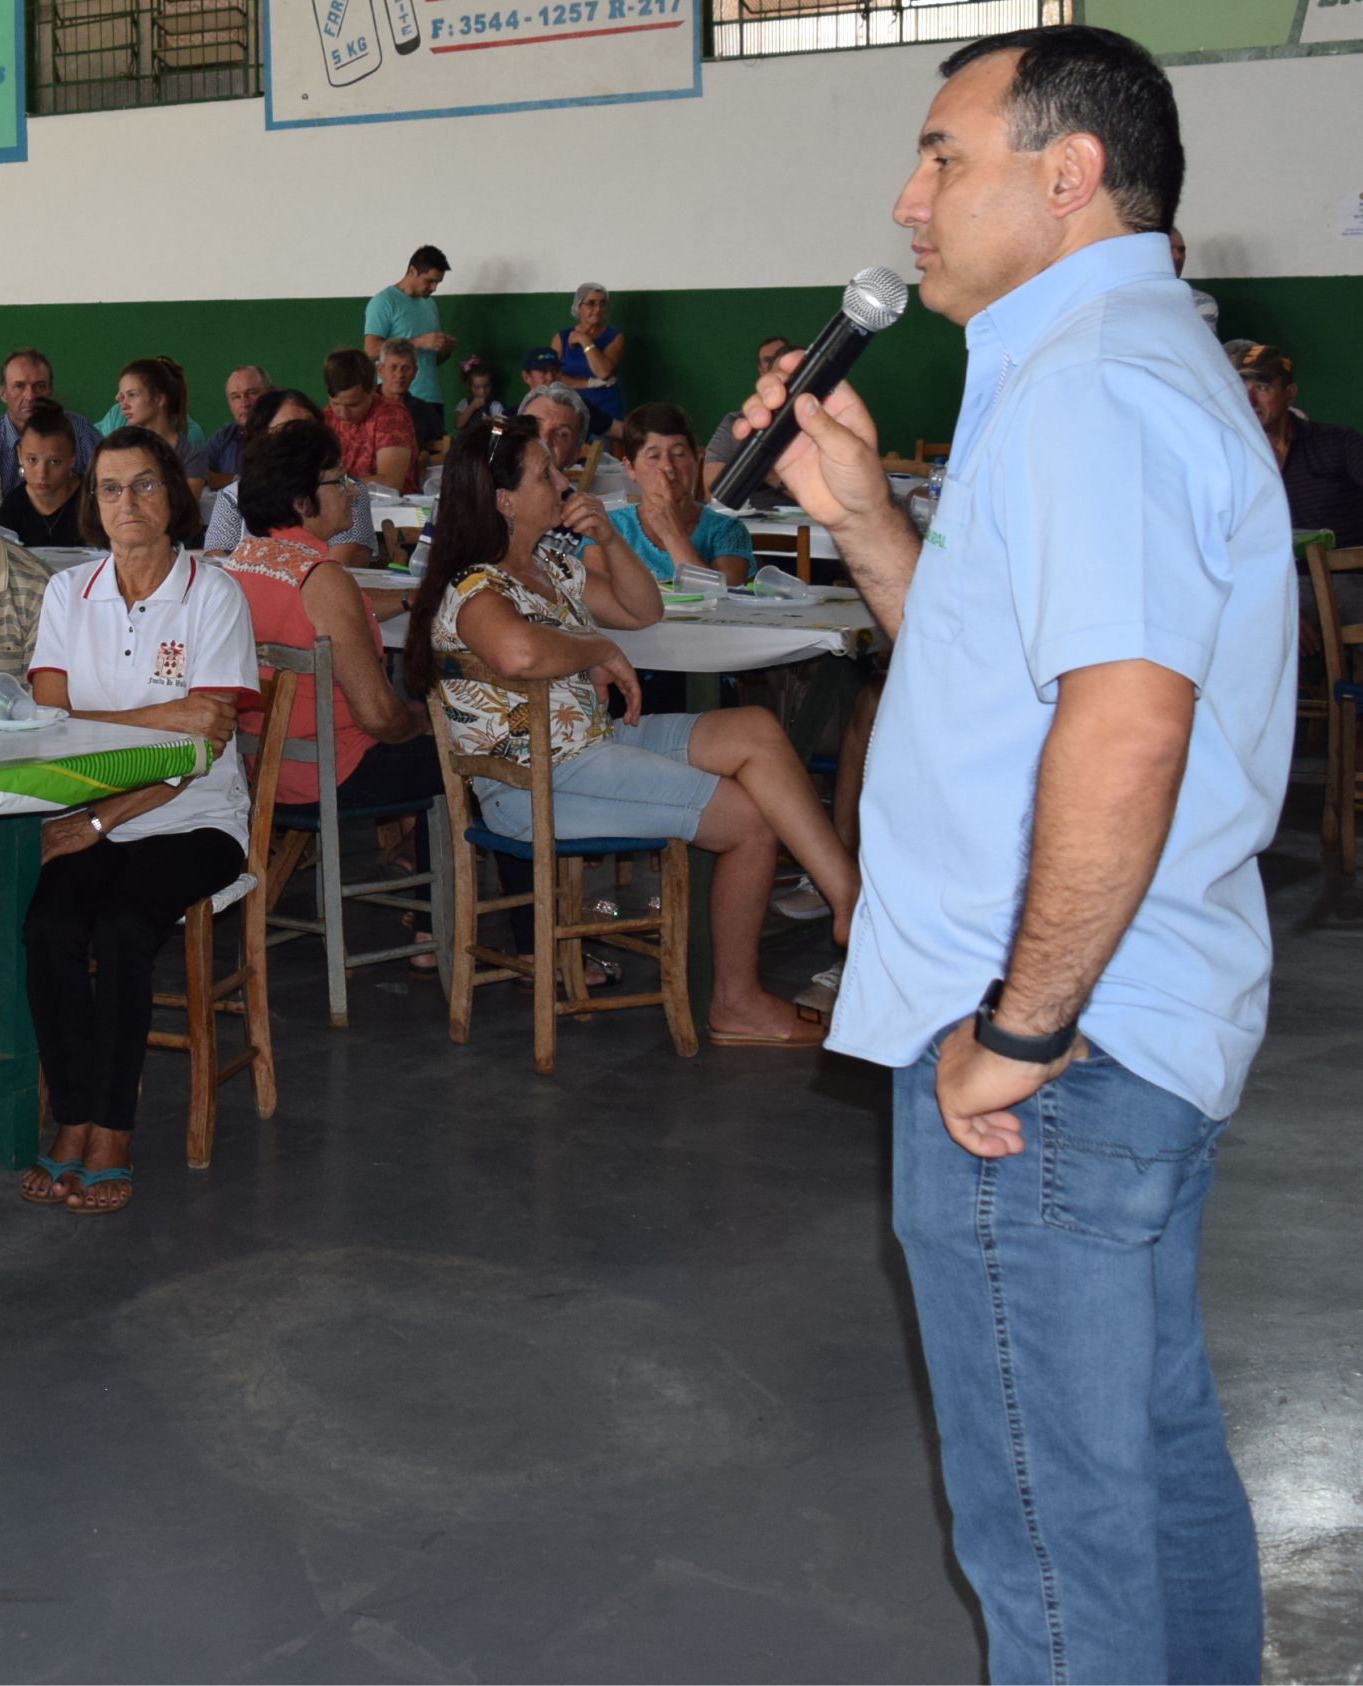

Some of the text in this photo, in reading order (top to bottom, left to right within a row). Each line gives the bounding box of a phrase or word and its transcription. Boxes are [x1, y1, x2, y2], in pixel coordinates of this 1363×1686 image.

[323, 0, 345, 37] FAR
[431, 1, 599, 39] F:3544-1257
[332, 36, 368, 65] 5 KG
